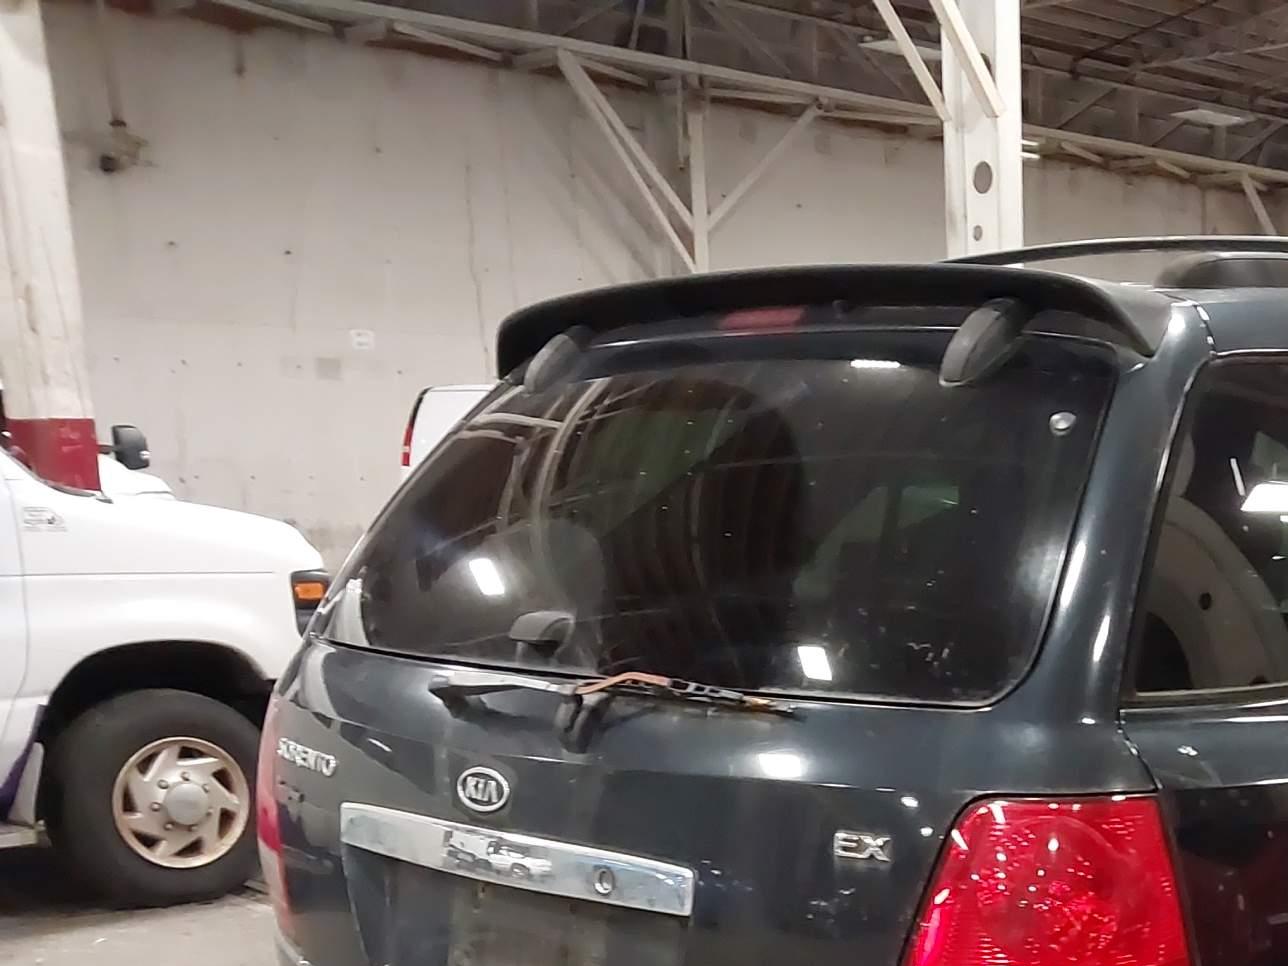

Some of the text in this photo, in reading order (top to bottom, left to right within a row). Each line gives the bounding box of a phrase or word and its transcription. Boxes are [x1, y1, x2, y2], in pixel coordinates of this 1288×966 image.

[276, 737, 337, 776] SORENTO
[465, 776, 499, 803] KIA
[833, 832, 892, 862] EX
